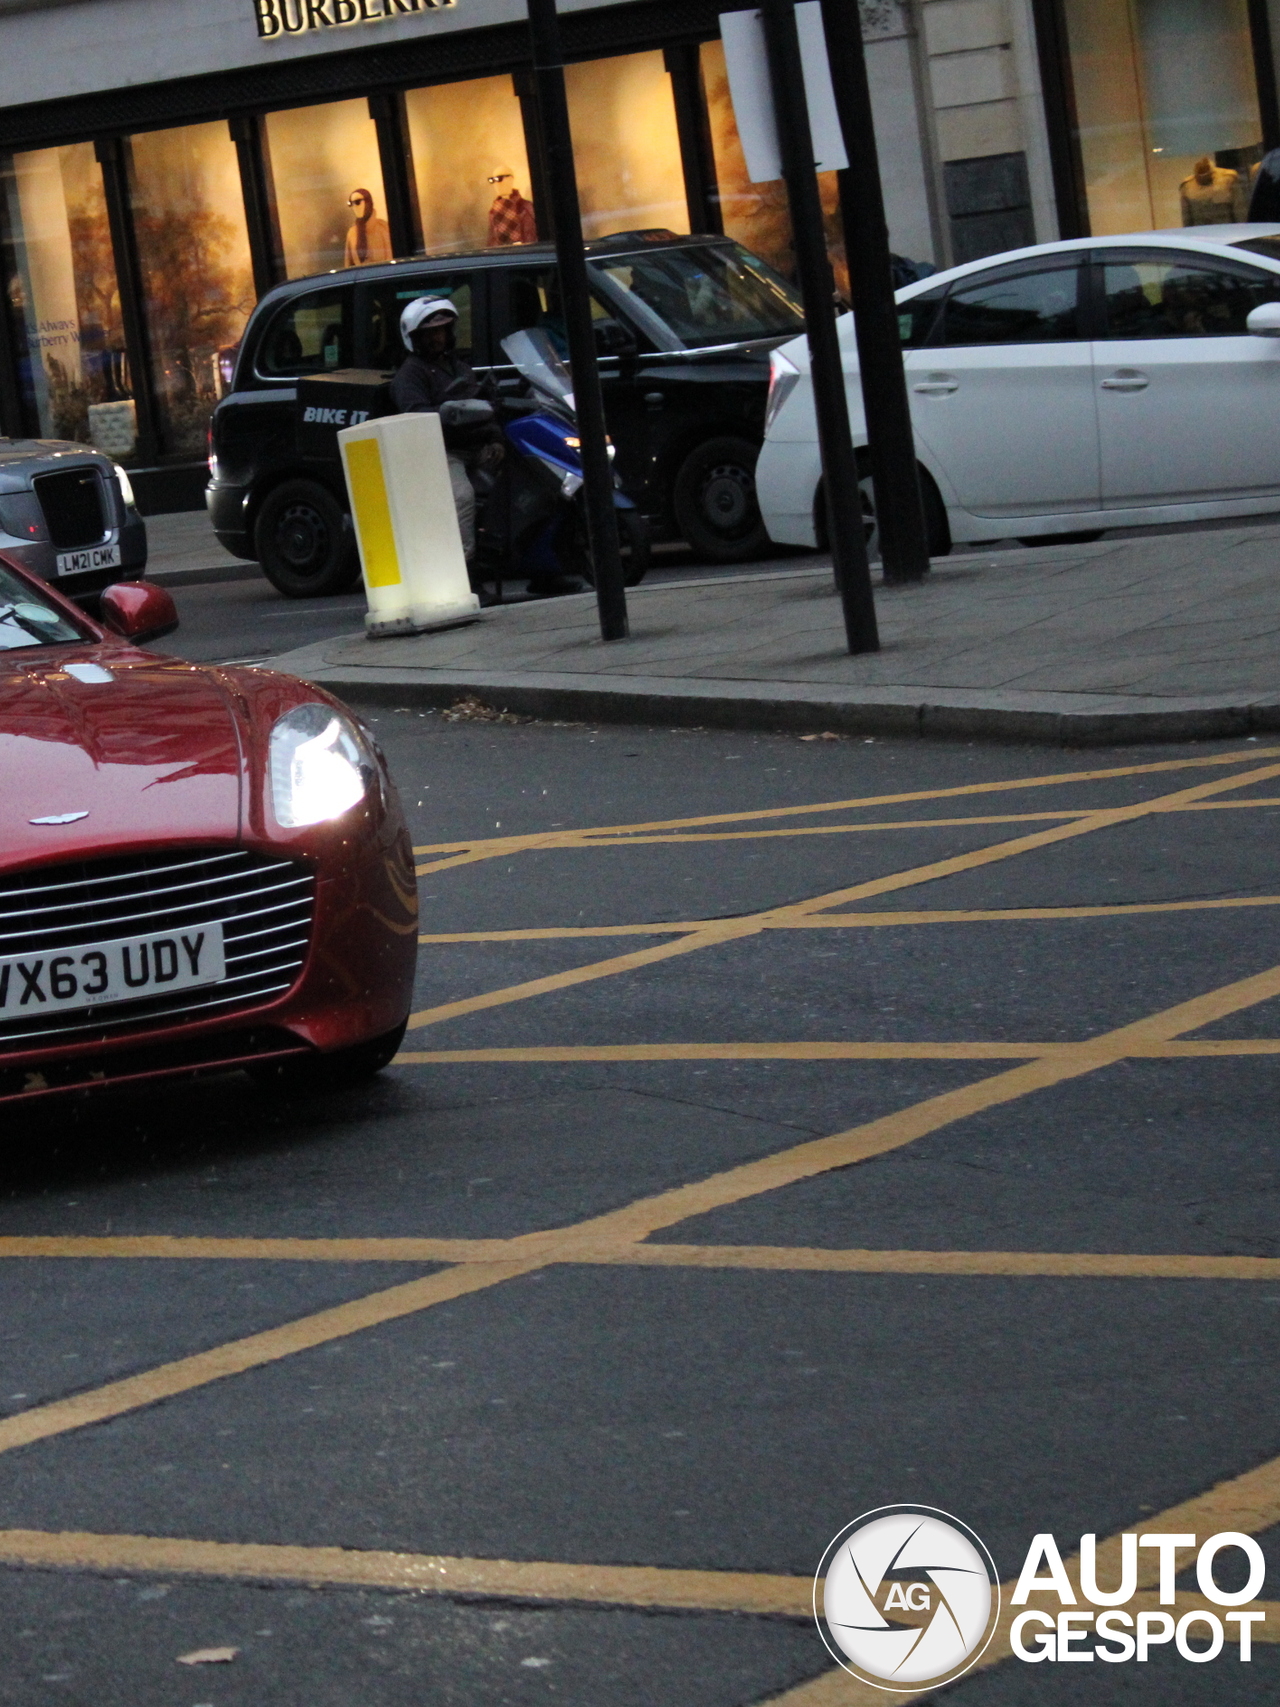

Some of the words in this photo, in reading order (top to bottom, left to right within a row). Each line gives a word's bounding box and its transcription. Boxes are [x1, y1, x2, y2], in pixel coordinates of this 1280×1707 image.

[303, 406, 347, 424] BIKE
[350, 410, 369, 425] IT
[64, 552, 91, 572] LM21
[93, 548, 115, 566] CMK
[122, 932, 205, 988] UDY
